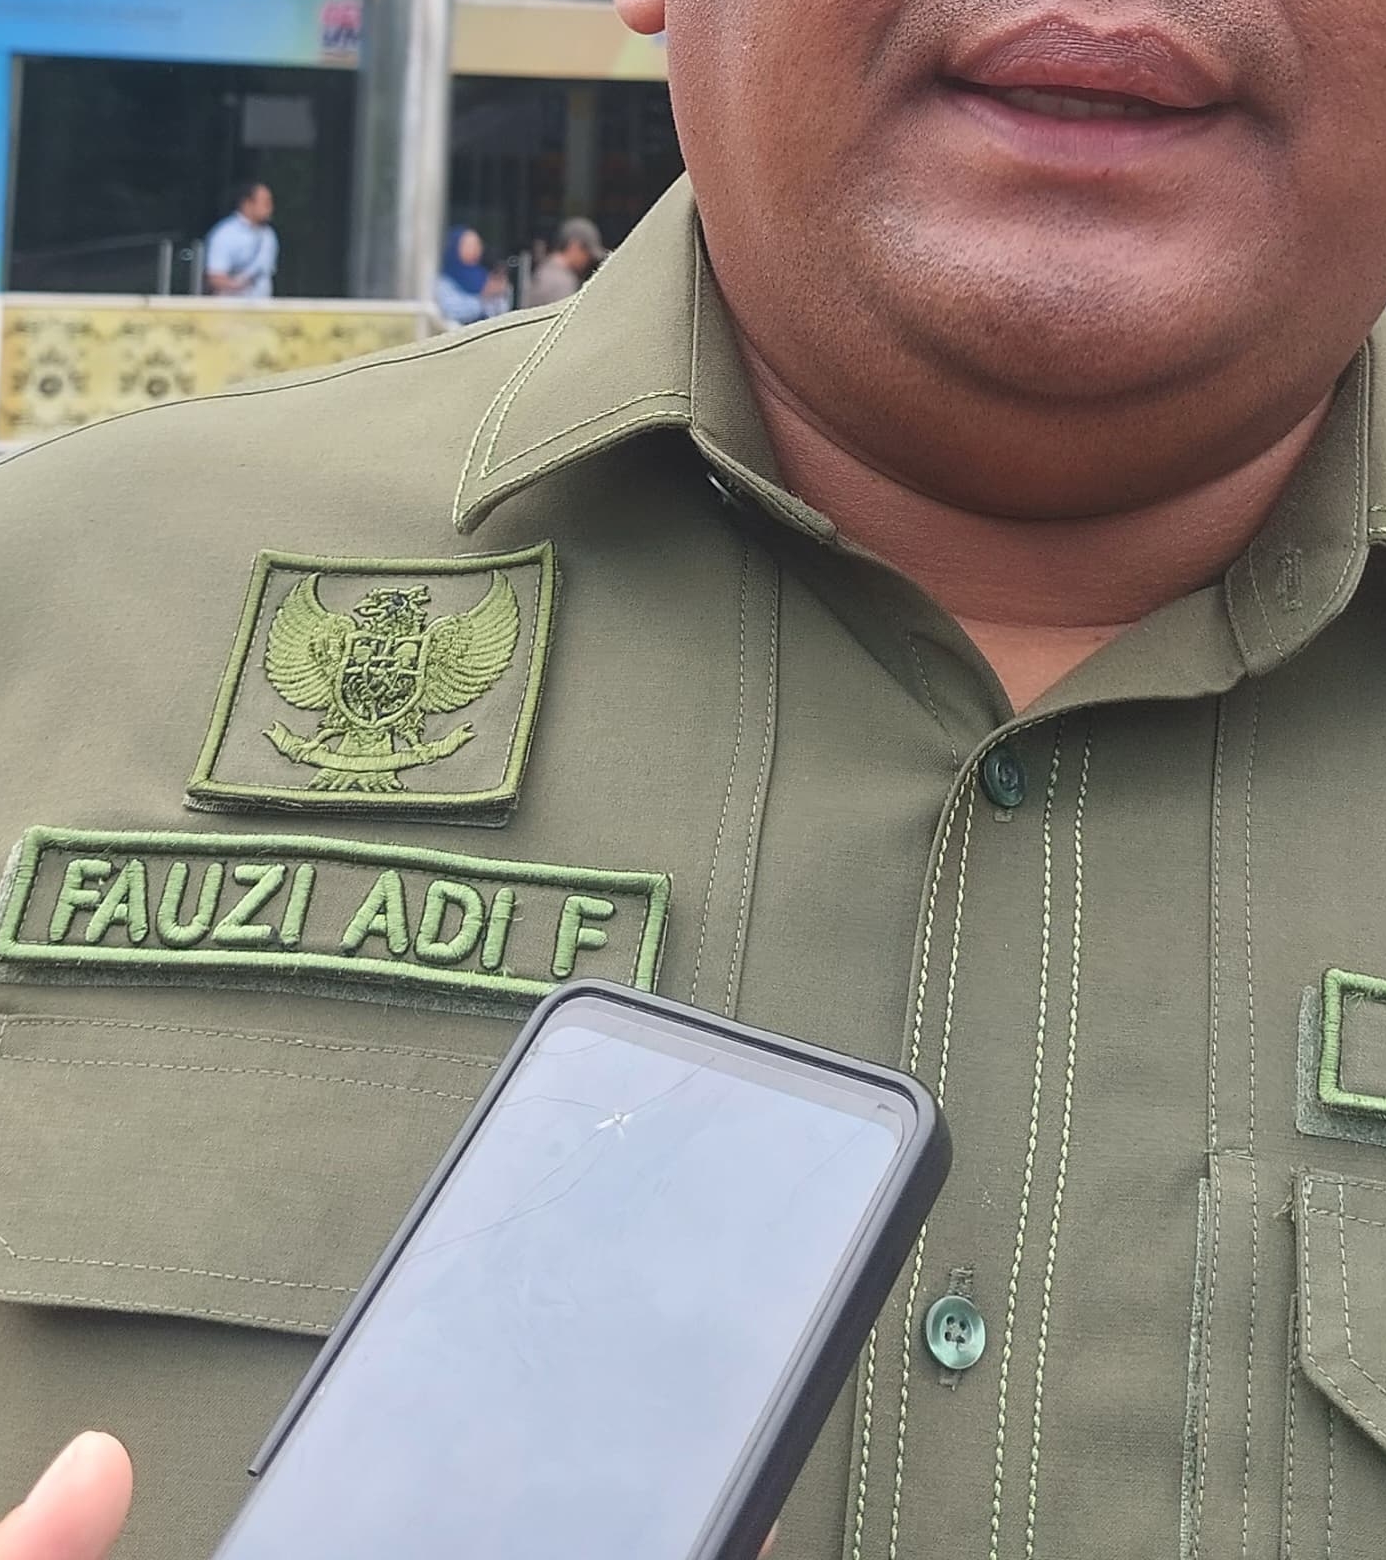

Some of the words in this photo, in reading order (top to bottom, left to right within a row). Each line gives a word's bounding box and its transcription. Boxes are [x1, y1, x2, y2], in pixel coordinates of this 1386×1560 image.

[47, 856, 317, 951] FAUZI
[339, 869, 514, 971] ADI
[550, 895, 615, 979] F
